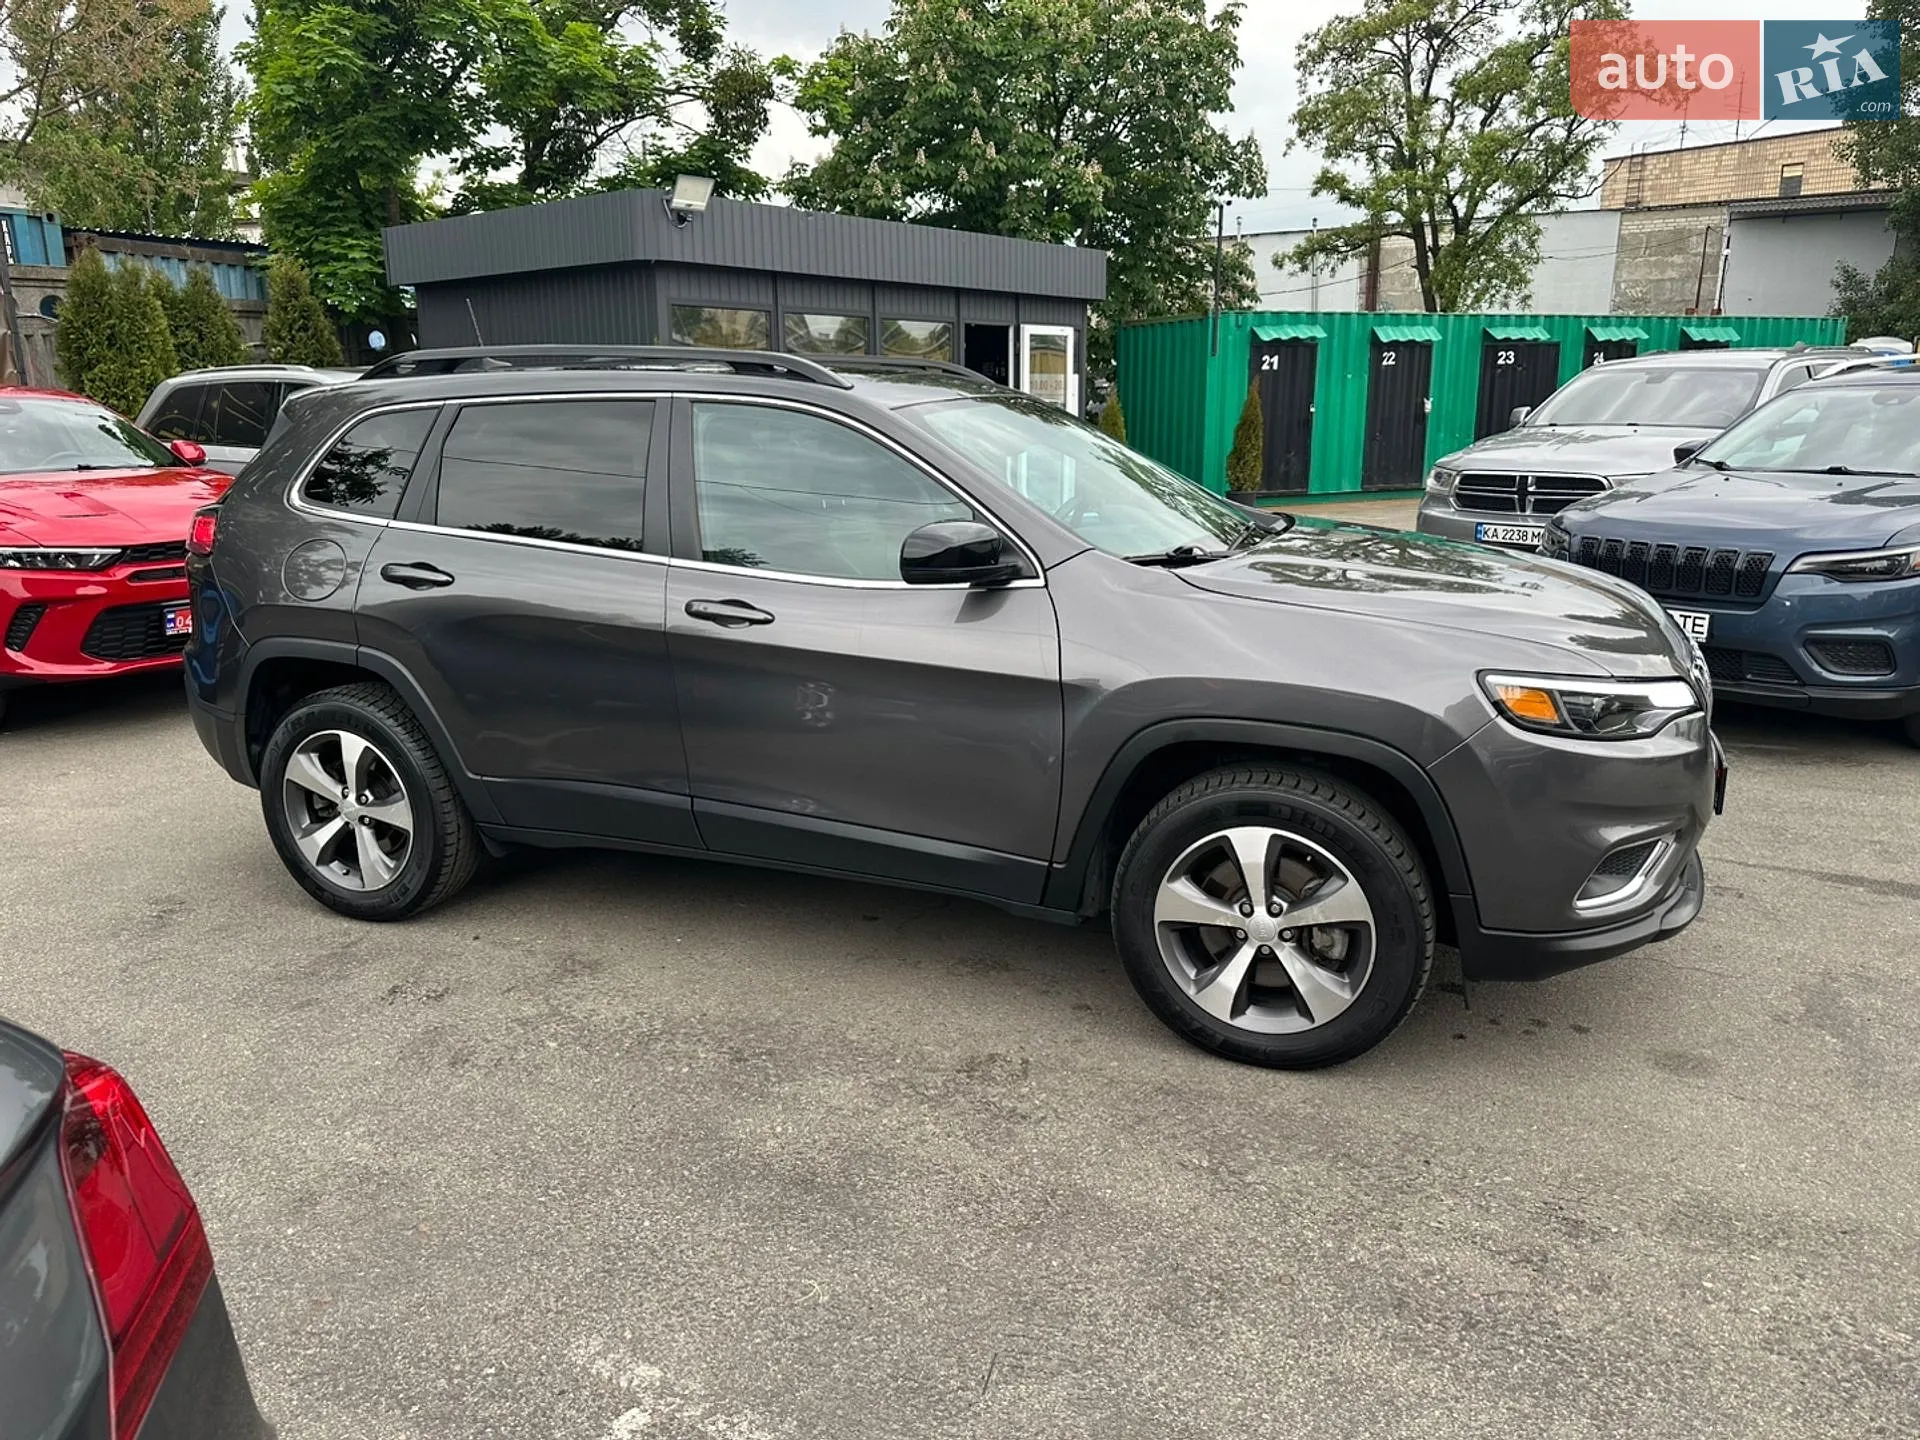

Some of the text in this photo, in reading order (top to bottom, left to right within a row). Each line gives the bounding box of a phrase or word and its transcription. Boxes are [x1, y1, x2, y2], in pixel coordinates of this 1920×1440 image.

[1261, 355, 1279, 370] 21
[1382, 352, 1396, 365] 22
[1497, 351, 1515, 365] 23
[1482, 527, 1498, 539] KA
[1501, 528, 1528, 542] 2238
[1679, 614, 1706, 635] TE
